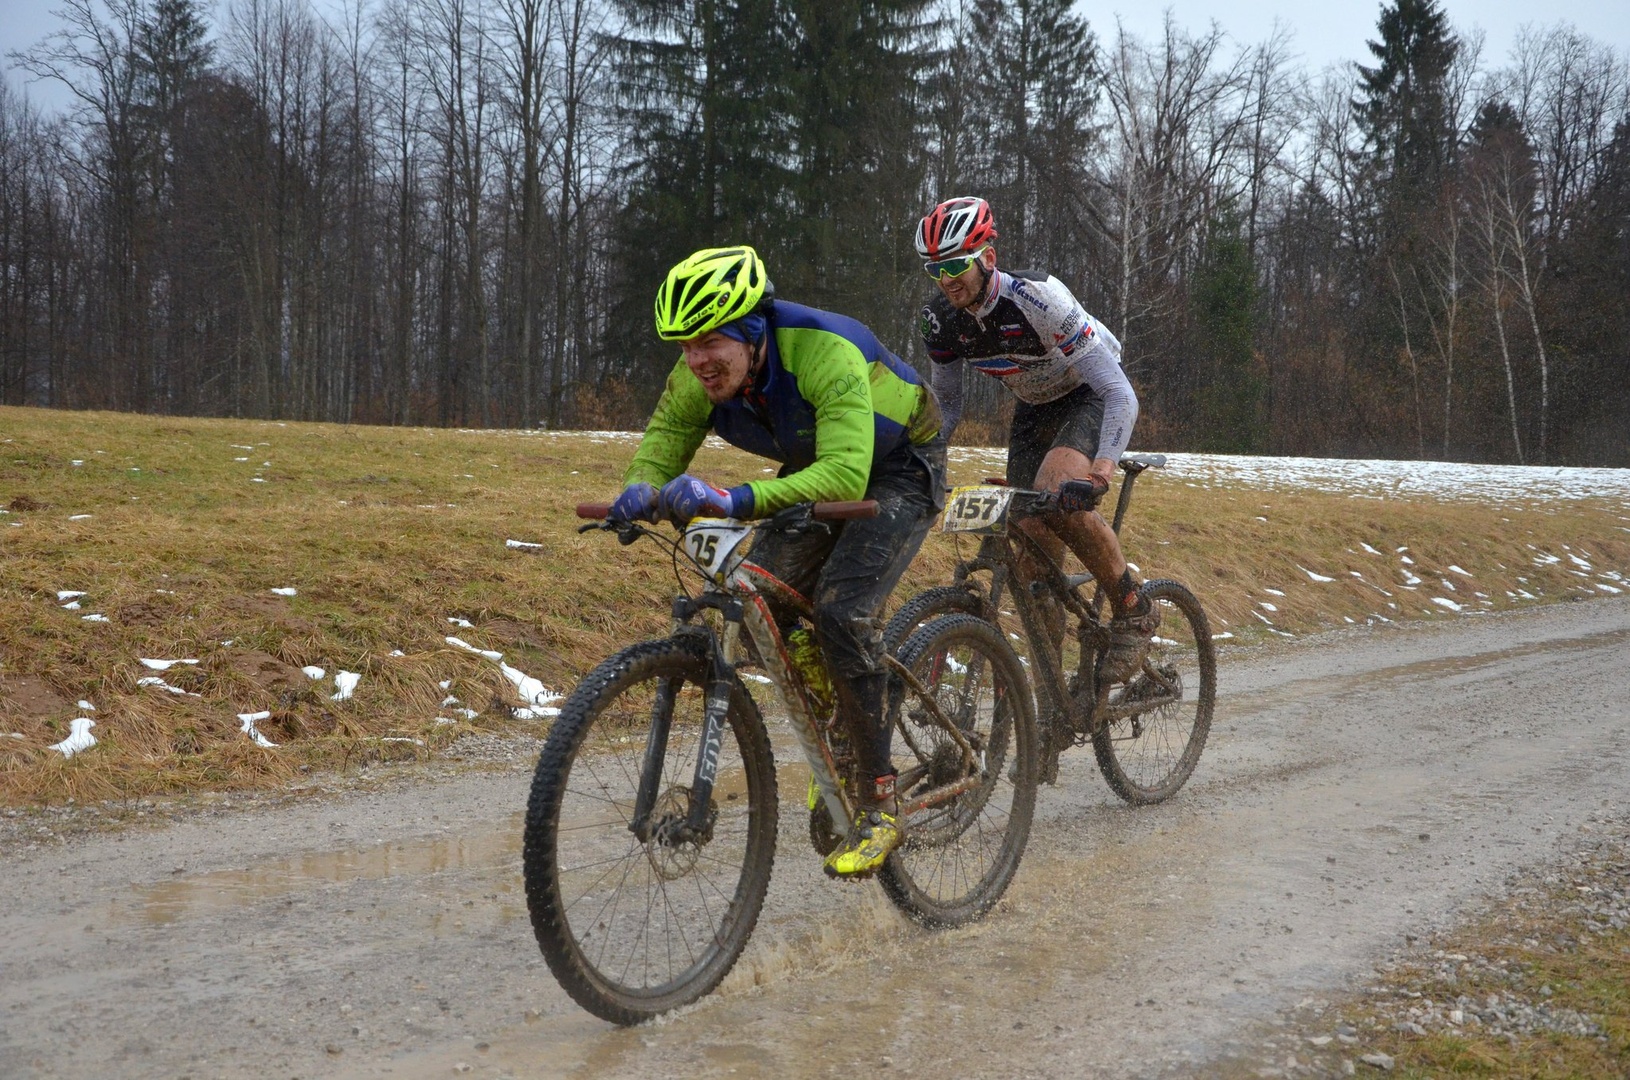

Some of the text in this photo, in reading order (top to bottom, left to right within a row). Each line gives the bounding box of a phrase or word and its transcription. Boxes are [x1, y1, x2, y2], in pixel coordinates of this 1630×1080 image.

[682, 304, 715, 329] Selev
[955, 497, 998, 520] 157
[692, 533, 720, 567] 25
[699, 714, 725, 785] FOX
